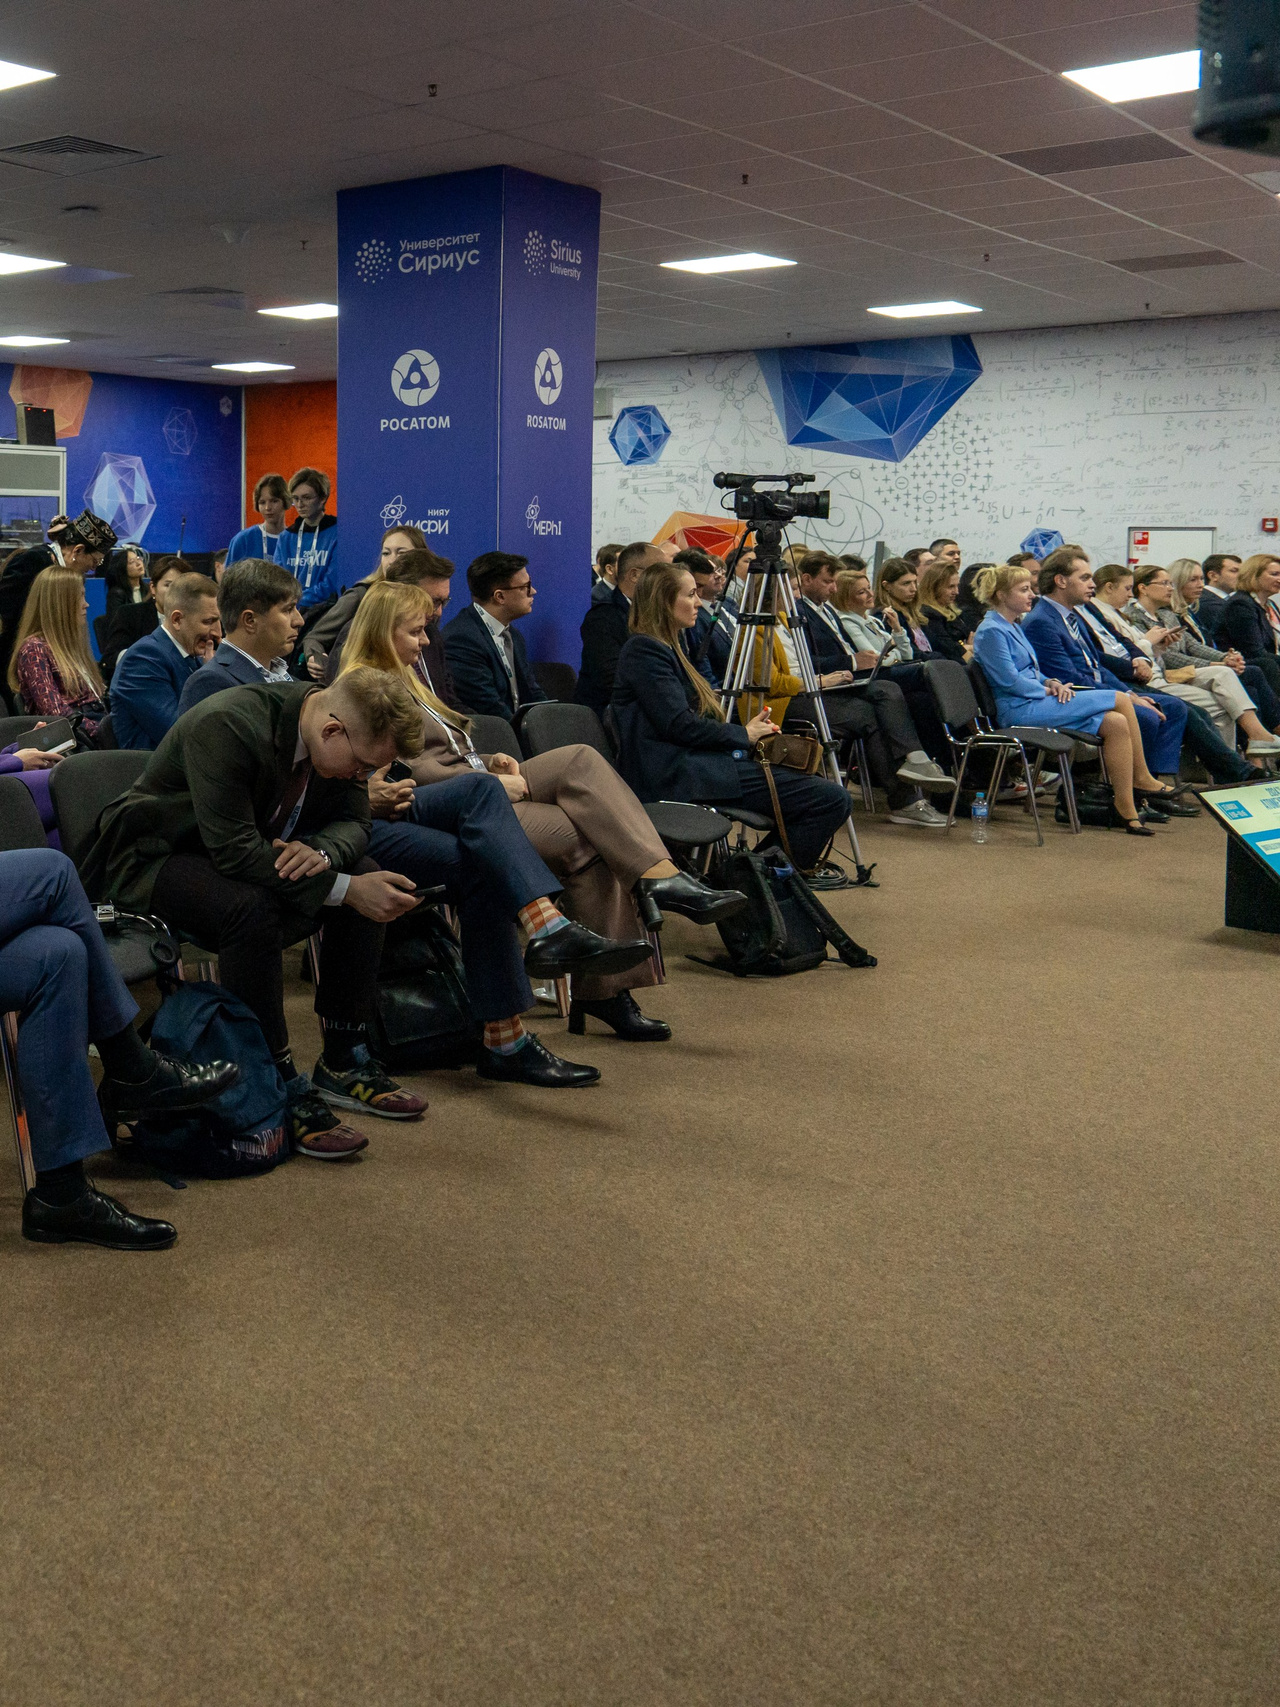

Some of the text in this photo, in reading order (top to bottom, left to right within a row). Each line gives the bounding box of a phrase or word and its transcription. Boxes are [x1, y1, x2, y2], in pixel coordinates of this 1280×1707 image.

[399, 233, 480, 252] Университет
[550, 239, 582, 265] Sirius
[398, 249, 480, 275] Сириус
[550, 262, 581, 281] University
[380, 415, 450, 432] РОСАТОМ
[527, 414, 566, 431] ROSATOM
[427, 509, 450, 517] НИЯУ
[533, 520, 562, 536] MEPhI
[325, 1020, 366, 1031] UCLA
[349, 1082, 374, 1102] N
